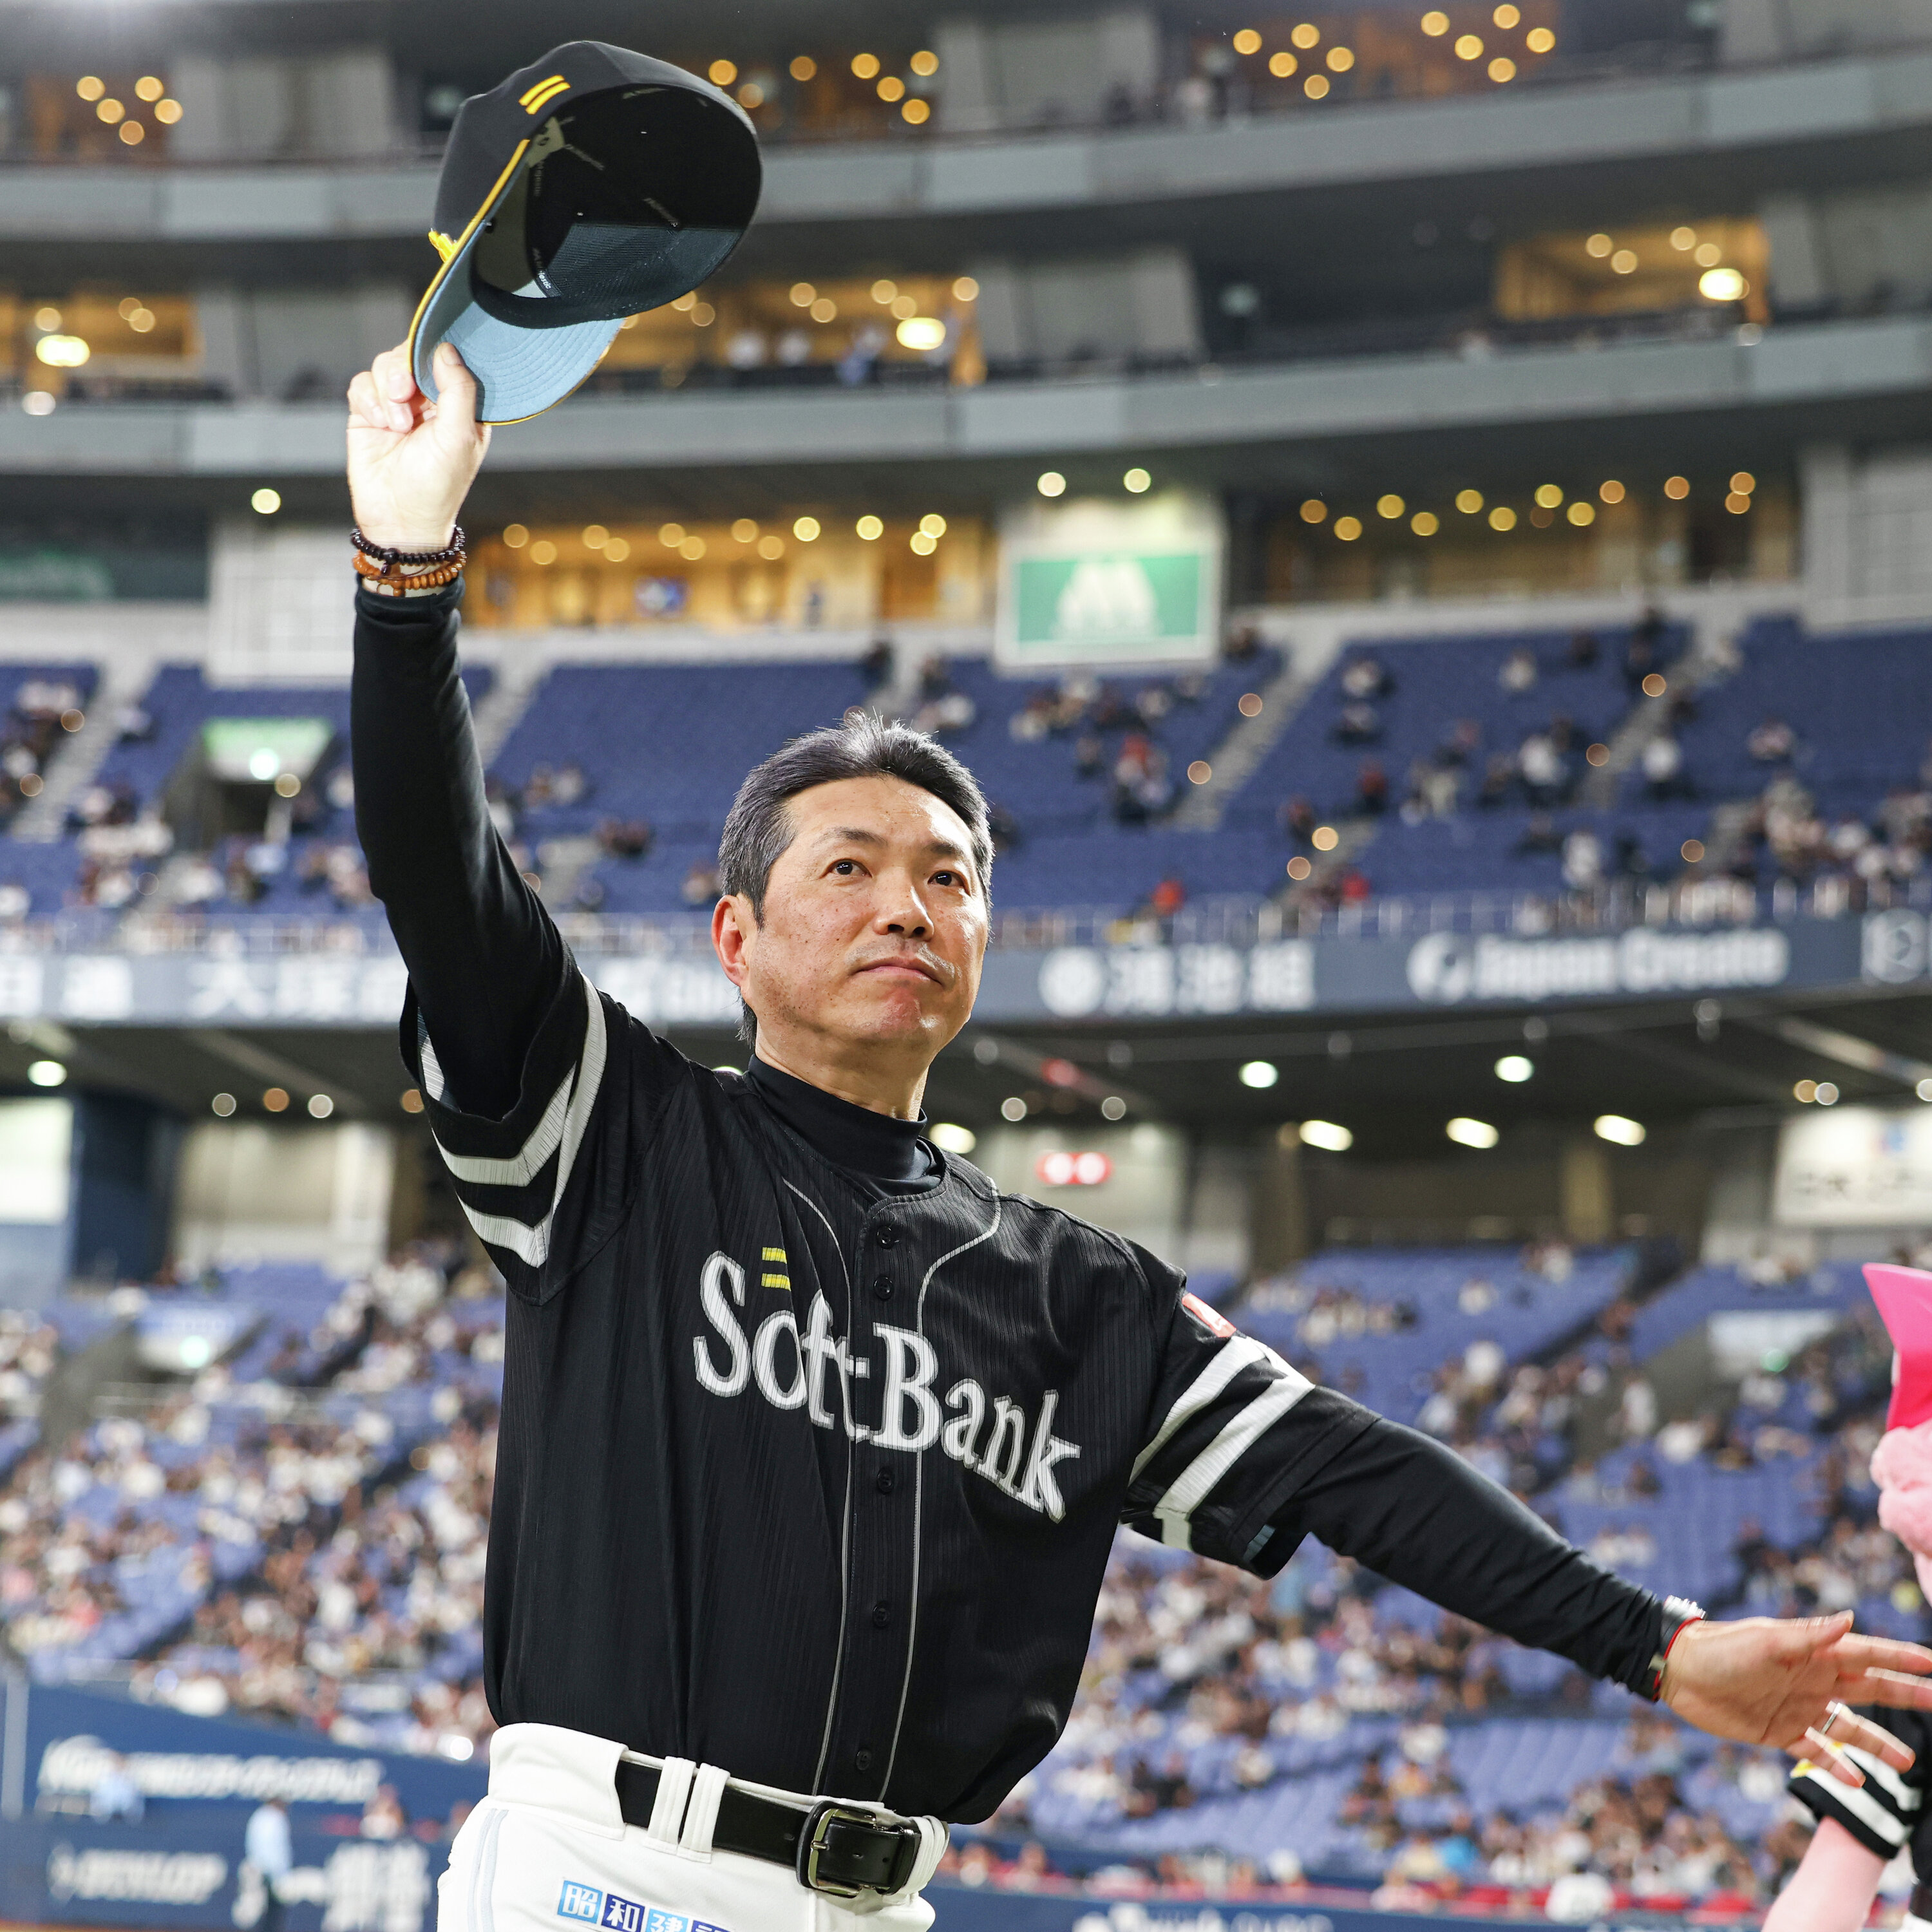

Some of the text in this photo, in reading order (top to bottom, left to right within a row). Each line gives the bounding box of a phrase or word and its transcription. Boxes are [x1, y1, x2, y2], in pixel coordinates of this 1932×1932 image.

[693, 1249, 1083, 1524] SoftBank
[561, 1883, 724, 1932] 昭和建
